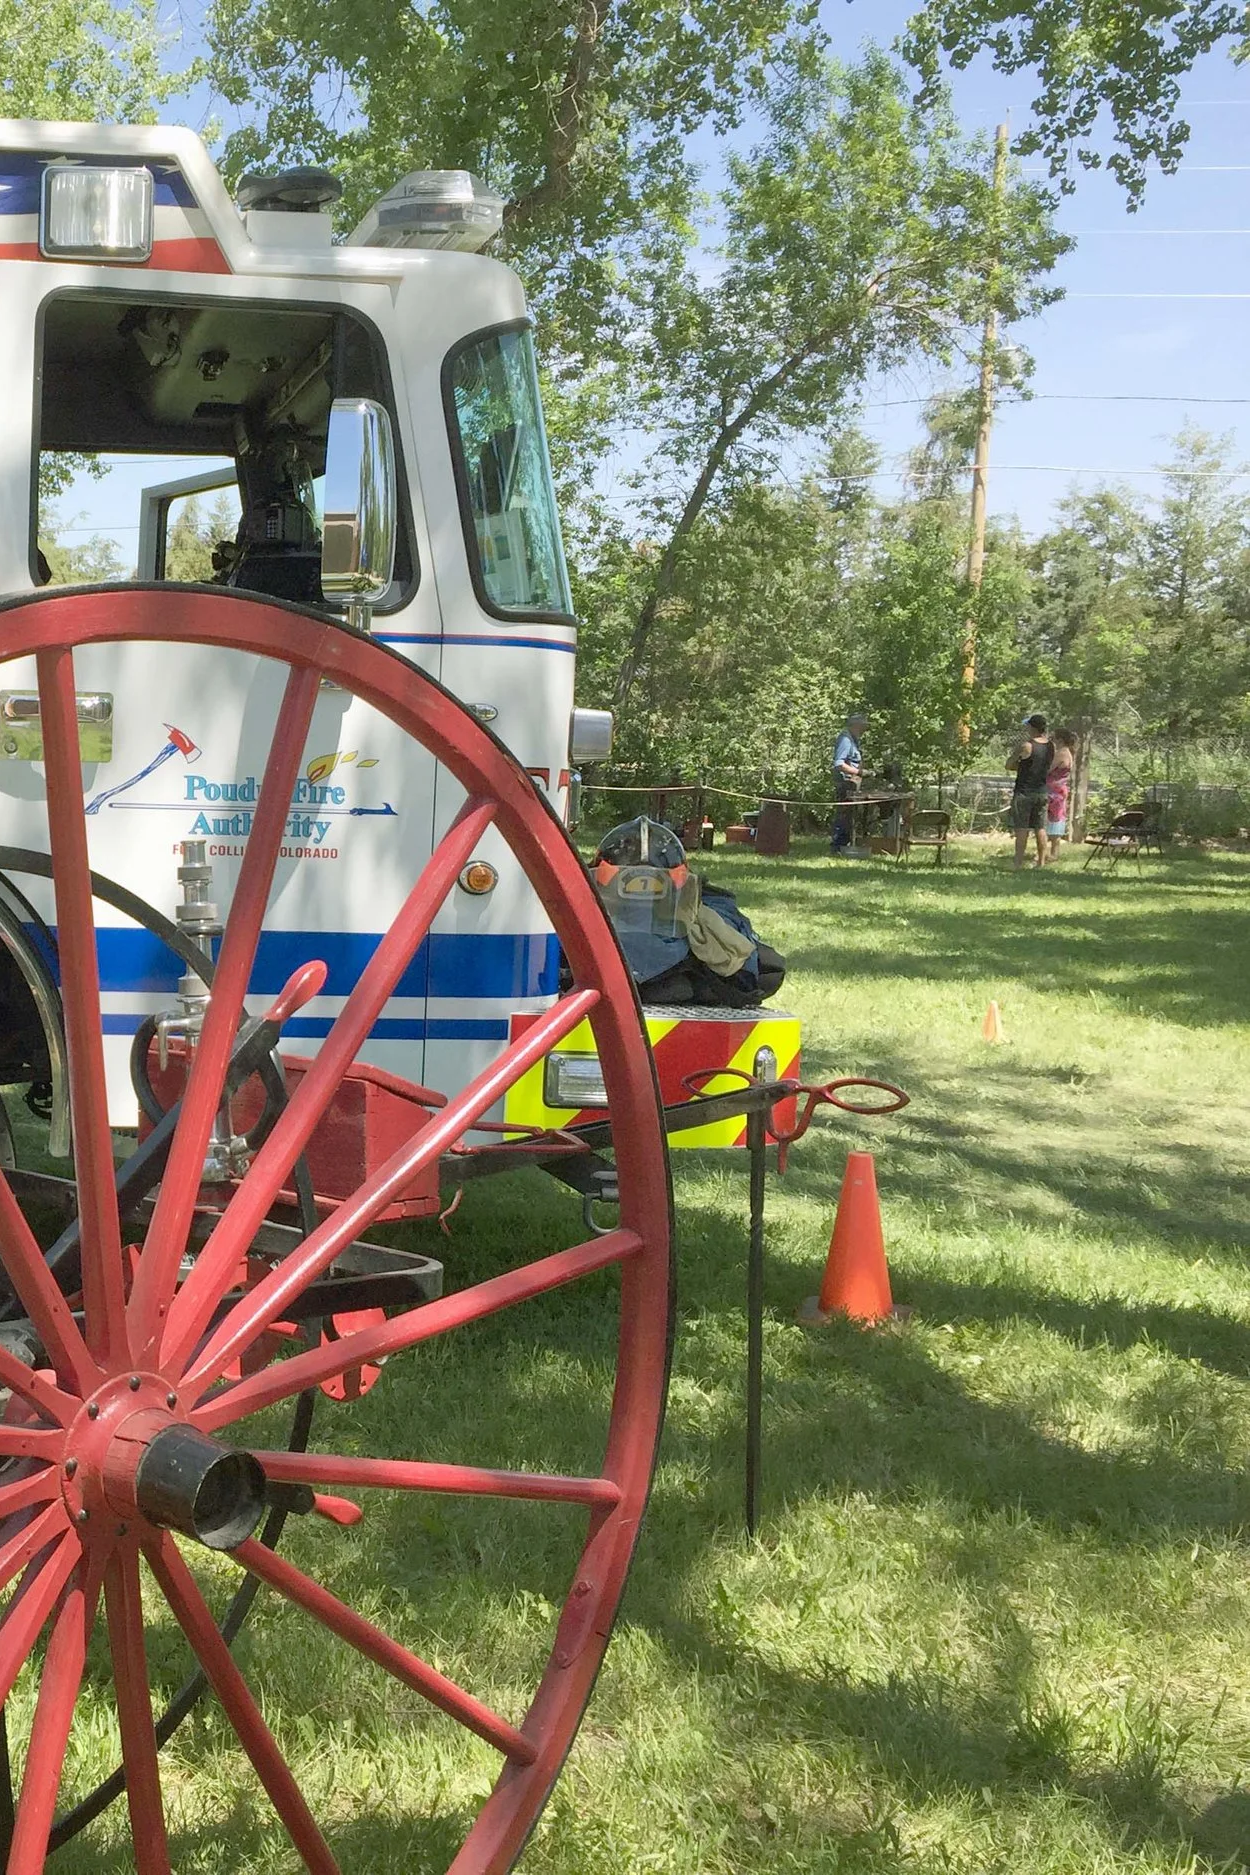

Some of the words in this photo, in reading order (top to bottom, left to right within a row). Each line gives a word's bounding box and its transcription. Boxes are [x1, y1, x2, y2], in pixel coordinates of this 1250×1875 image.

[183, 775, 262, 801] Poud
[292, 778, 345, 805] Fire
[209, 845, 244, 857] COLLI
[280, 846, 338, 859] OLORADO
